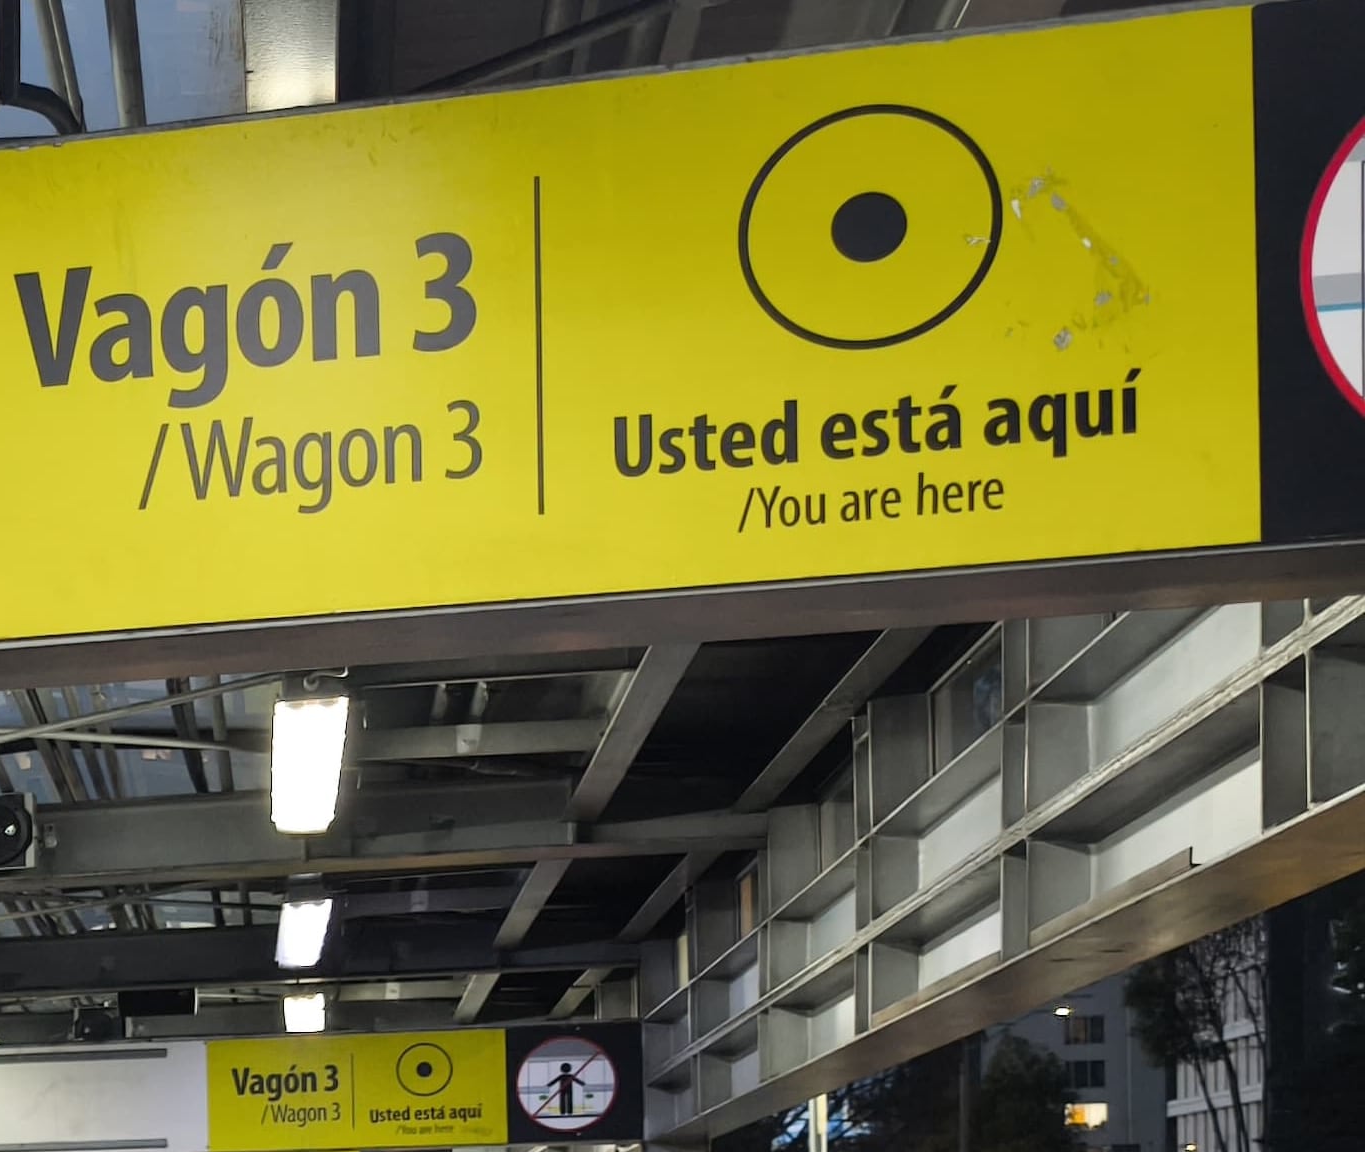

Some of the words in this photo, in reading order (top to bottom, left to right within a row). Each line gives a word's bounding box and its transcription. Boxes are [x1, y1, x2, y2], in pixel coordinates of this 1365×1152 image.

[14, 242, 381, 410] Vagón
[412, 232, 478, 352] 3
[614, 401, 799, 478] Usted
[821, 386, 962, 460] está
[984, 368, 1142, 458] aquí
[139, 417, 423, 514] /Wagon
[444, 400, 484, 479] 3
[738, 486, 827, 534] /You
[840, 486, 902, 523] are
[917, 473, 1005, 518] here
[231, 1064, 317, 1102] Vagón
[324, 1064, 339, 1092] 3
[369, 1105, 411, 1124] Usted
[414, 1105, 446, 1120] está
[449, 1102, 483, 1123] aquí
[260, 1103, 327, 1128] /Wagon
[332, 1102, 341, 1122] 3
